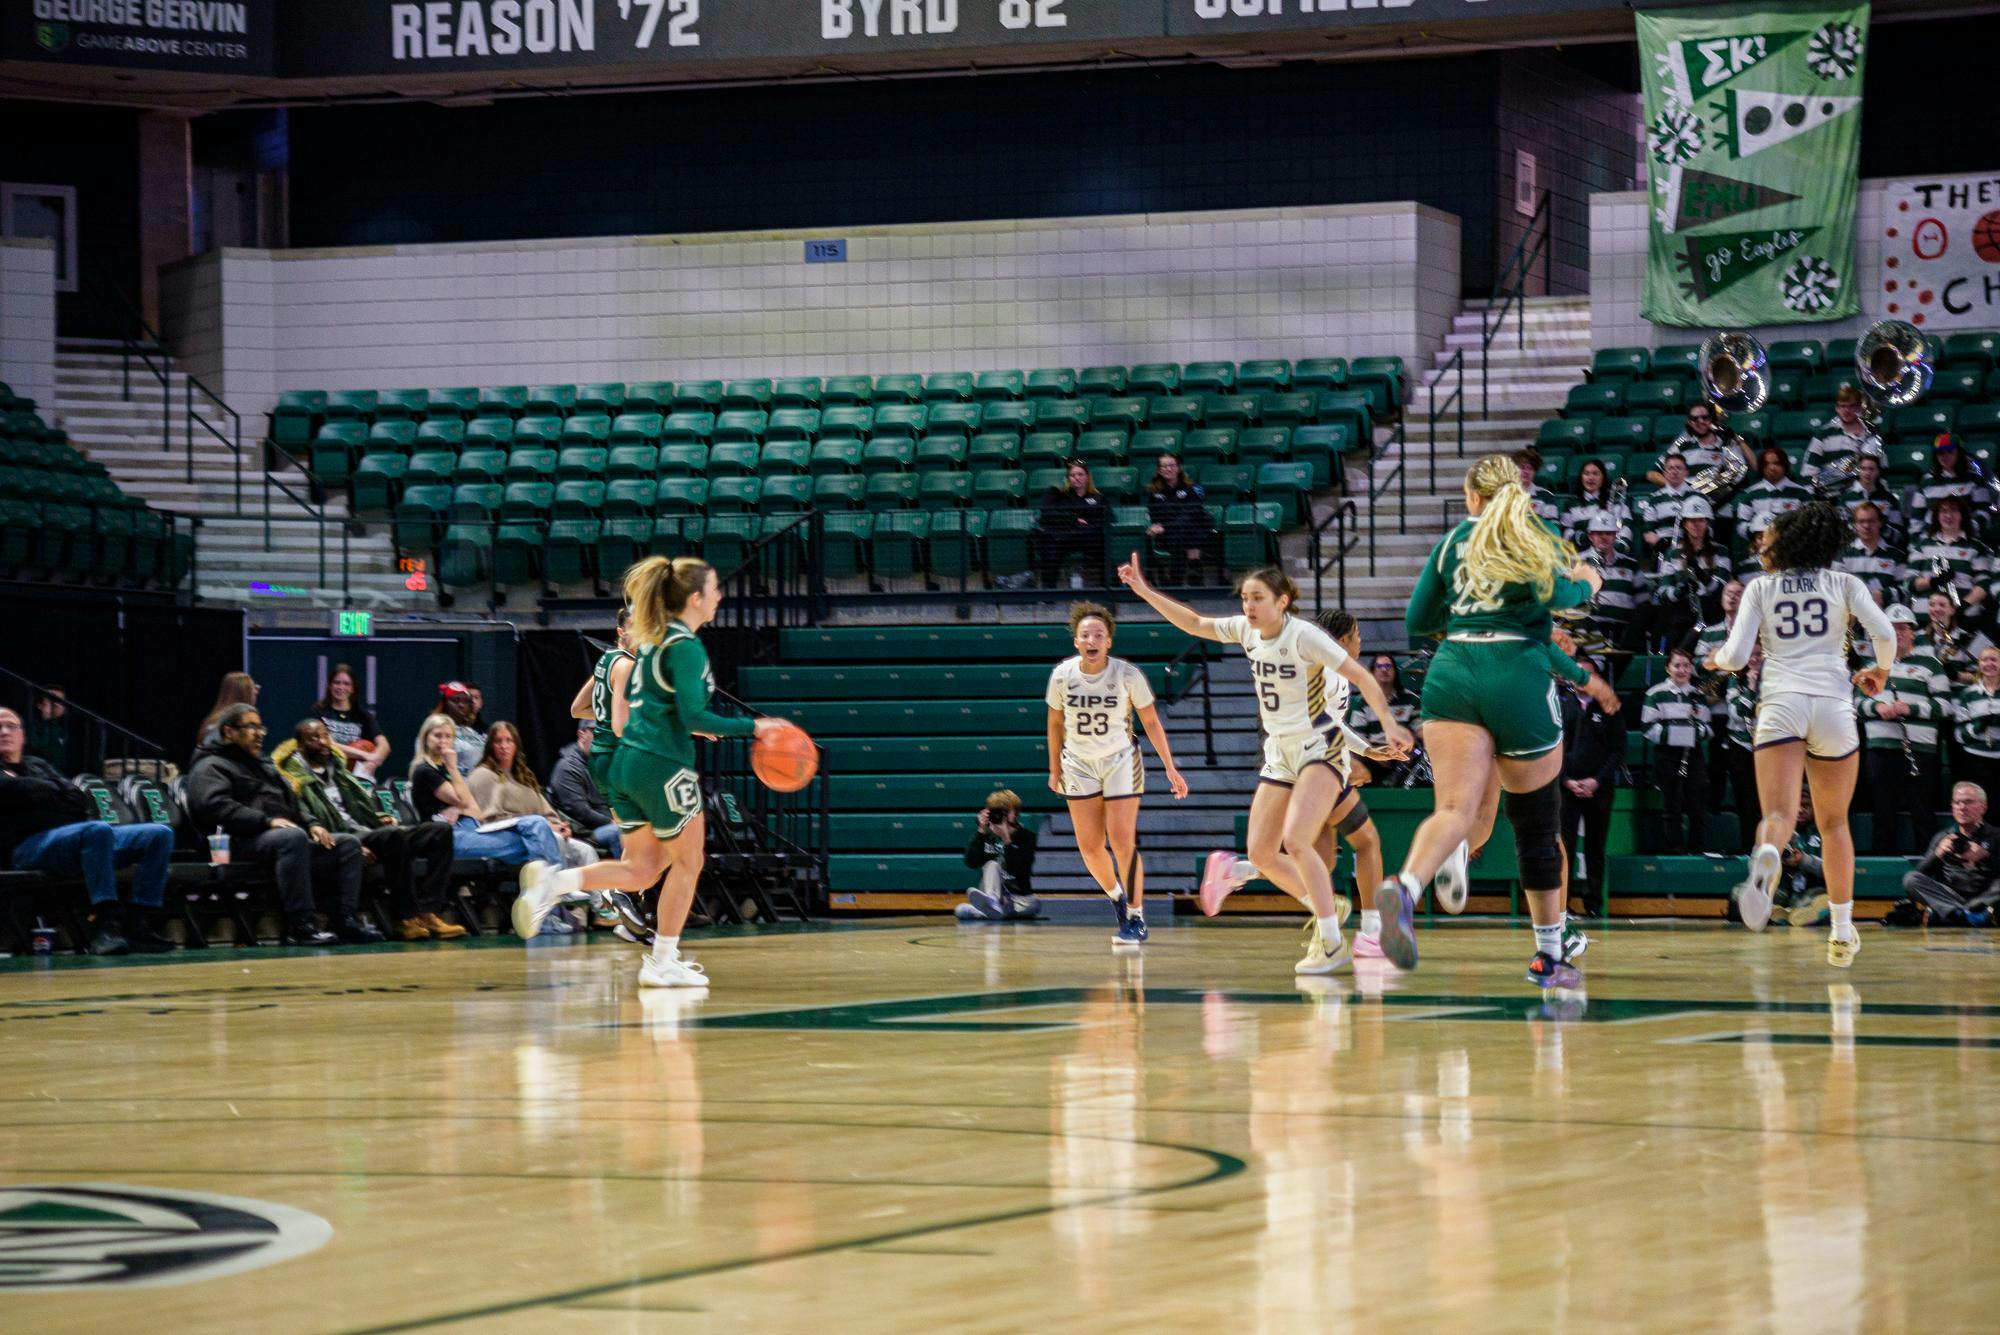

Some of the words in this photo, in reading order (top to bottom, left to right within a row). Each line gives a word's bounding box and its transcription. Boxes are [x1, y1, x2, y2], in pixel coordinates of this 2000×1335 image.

[33, 0, 142, 26] GEORGE
[145, 0, 248, 34] GERVIN
[391, 0, 596, 60] REASON
[1684, 181, 1756, 218] EMU
[812, 244, 839, 257] 115
[1740, 231, 1804, 262] Eagles
[1781, 577, 1818, 594] CLARK
[338, 611, 372, 636] EXIT
[1774, 598, 1829, 640] 33
[1066, 694, 1118, 708] ZIPS
[1260, 681, 1280, 712] 5
[1077, 712, 1109, 736] 23
[677, 782, 697, 808] E
